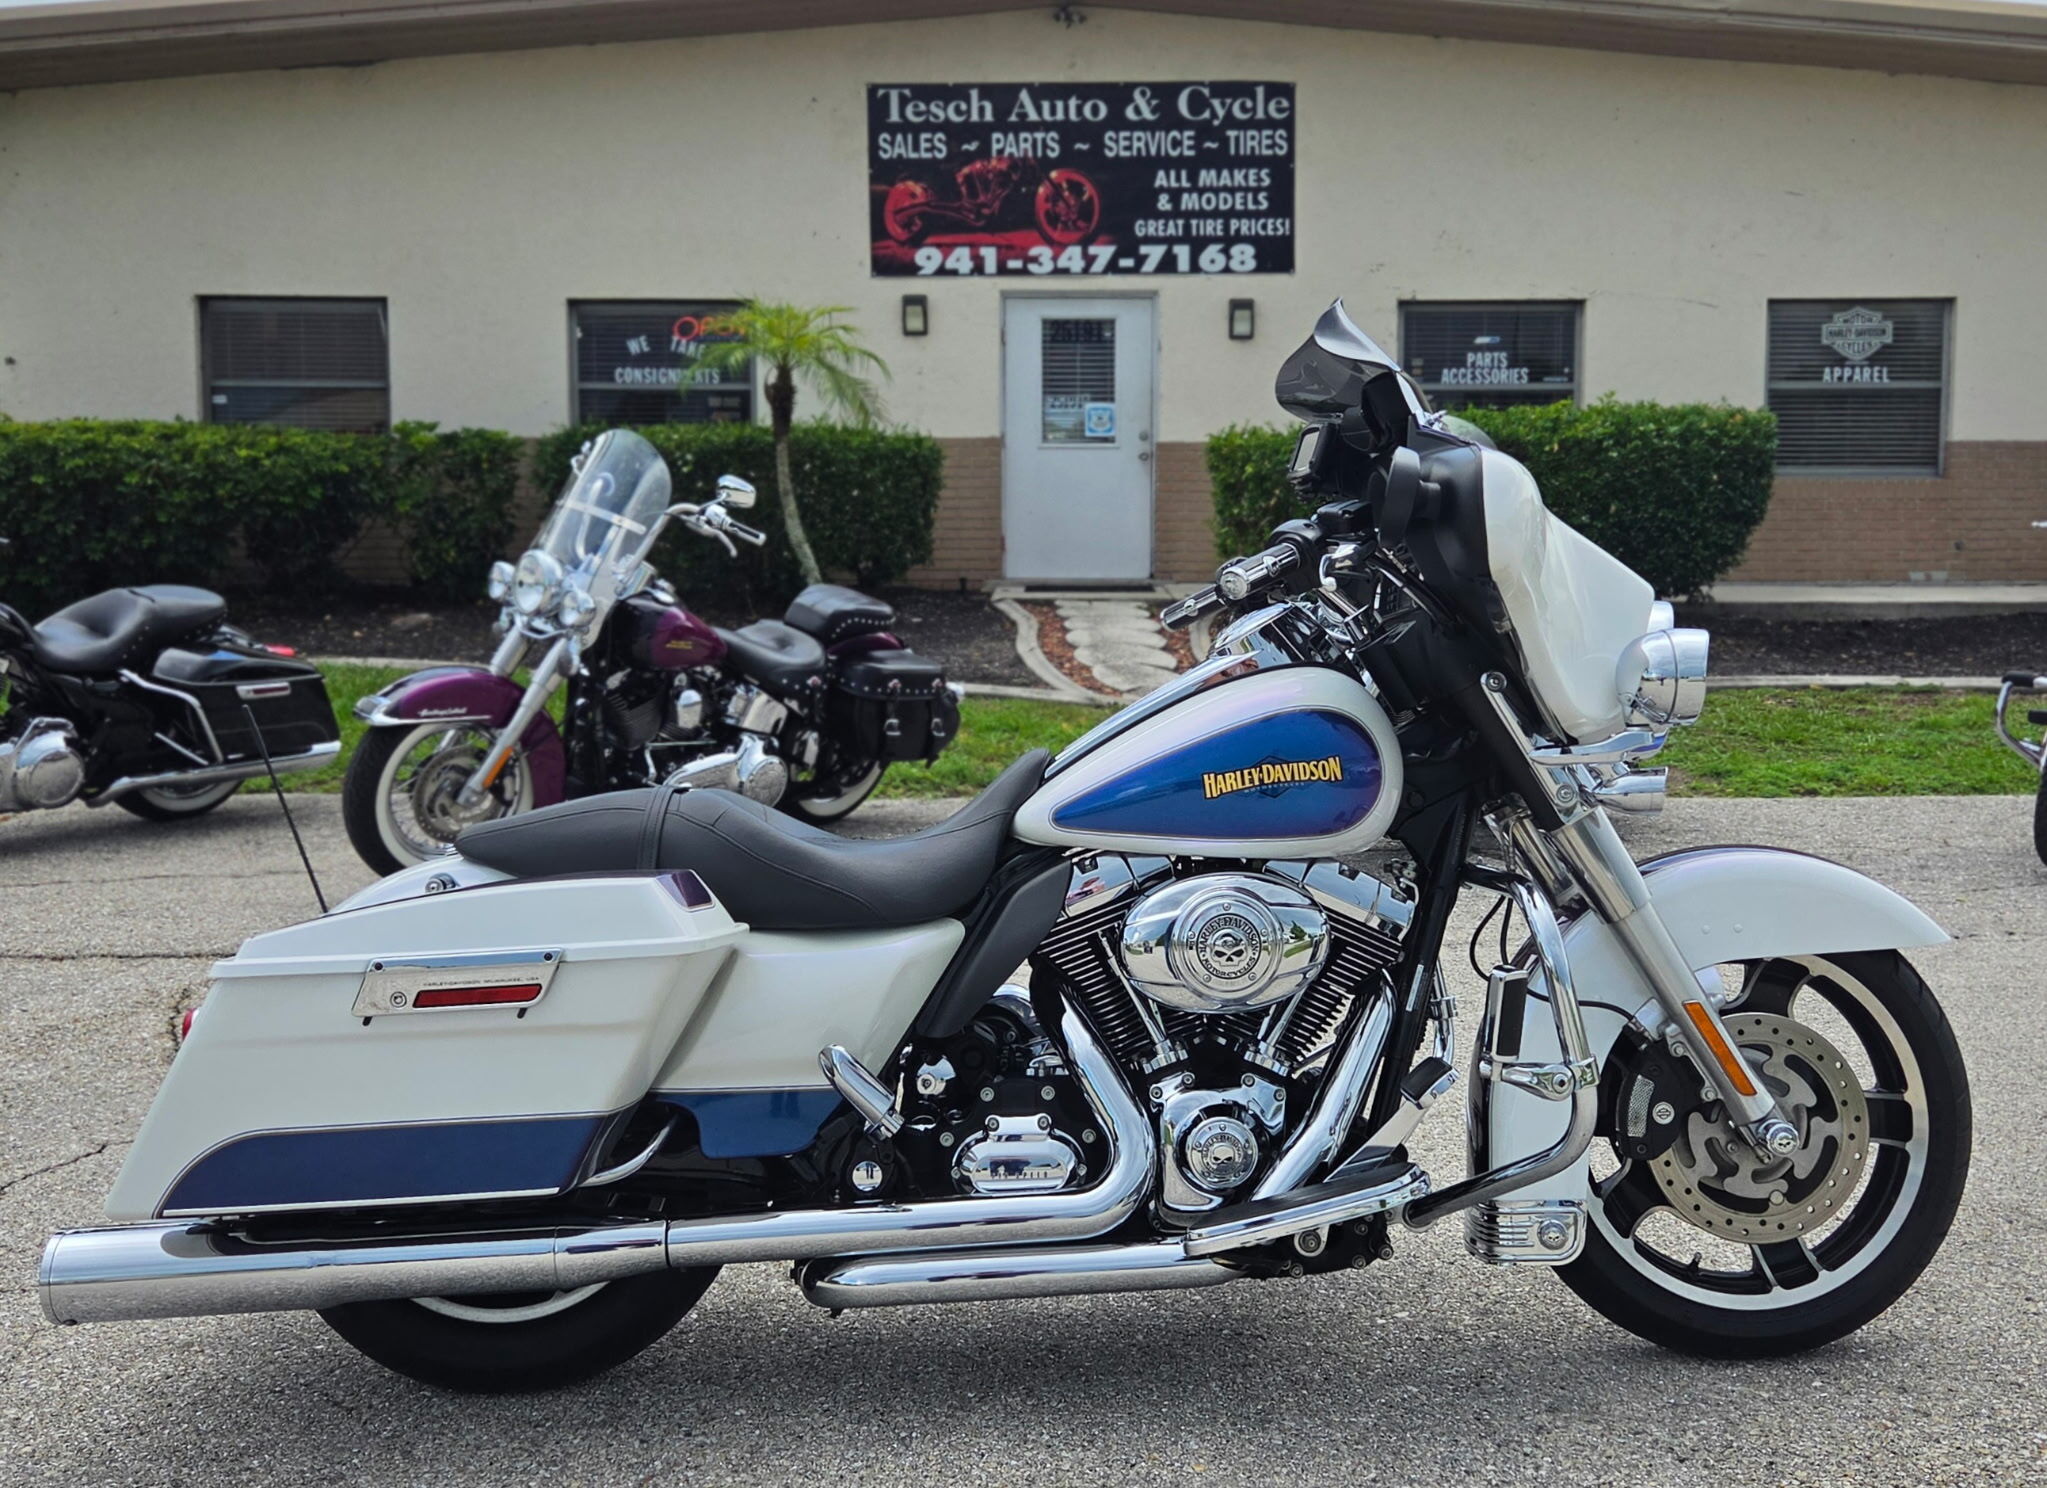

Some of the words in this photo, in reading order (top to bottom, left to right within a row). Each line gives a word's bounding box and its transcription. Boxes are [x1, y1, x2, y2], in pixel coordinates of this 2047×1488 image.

[877, 88, 994, 123] Tesch
[1007, 87, 1108, 122] Auto
[1124, 86, 1161, 122] &
[1177, 85, 1290, 126] Cycle
[878, 132, 947, 159] SALES
[991, 132, 1060, 158] PARTS
[1104, 130, 1196, 158] SERVICE
[1226, 129, 1288, 156] TIRES
[1154, 169, 1191, 188] ALL
[1198, 168, 1271, 188] MAKES
[1156, 193, 1172, 211] &
[1180, 192, 1269, 211] MODELS
[1134, 219, 1184, 237] GREAT
[1190, 219, 1224, 237] TIRE
[1230, 218, 1290, 236] PRICES!
[914, 243, 1257, 275] 941-347-7168
[626, 335, 650, 356] WE
[1466, 352, 1508, 368] PARTS
[614, 366, 720, 384] CONSIGNNTS
[1440, 368, 1530, 384] ACCESSORIES
[1822, 366, 1891, 383] APPAREL
